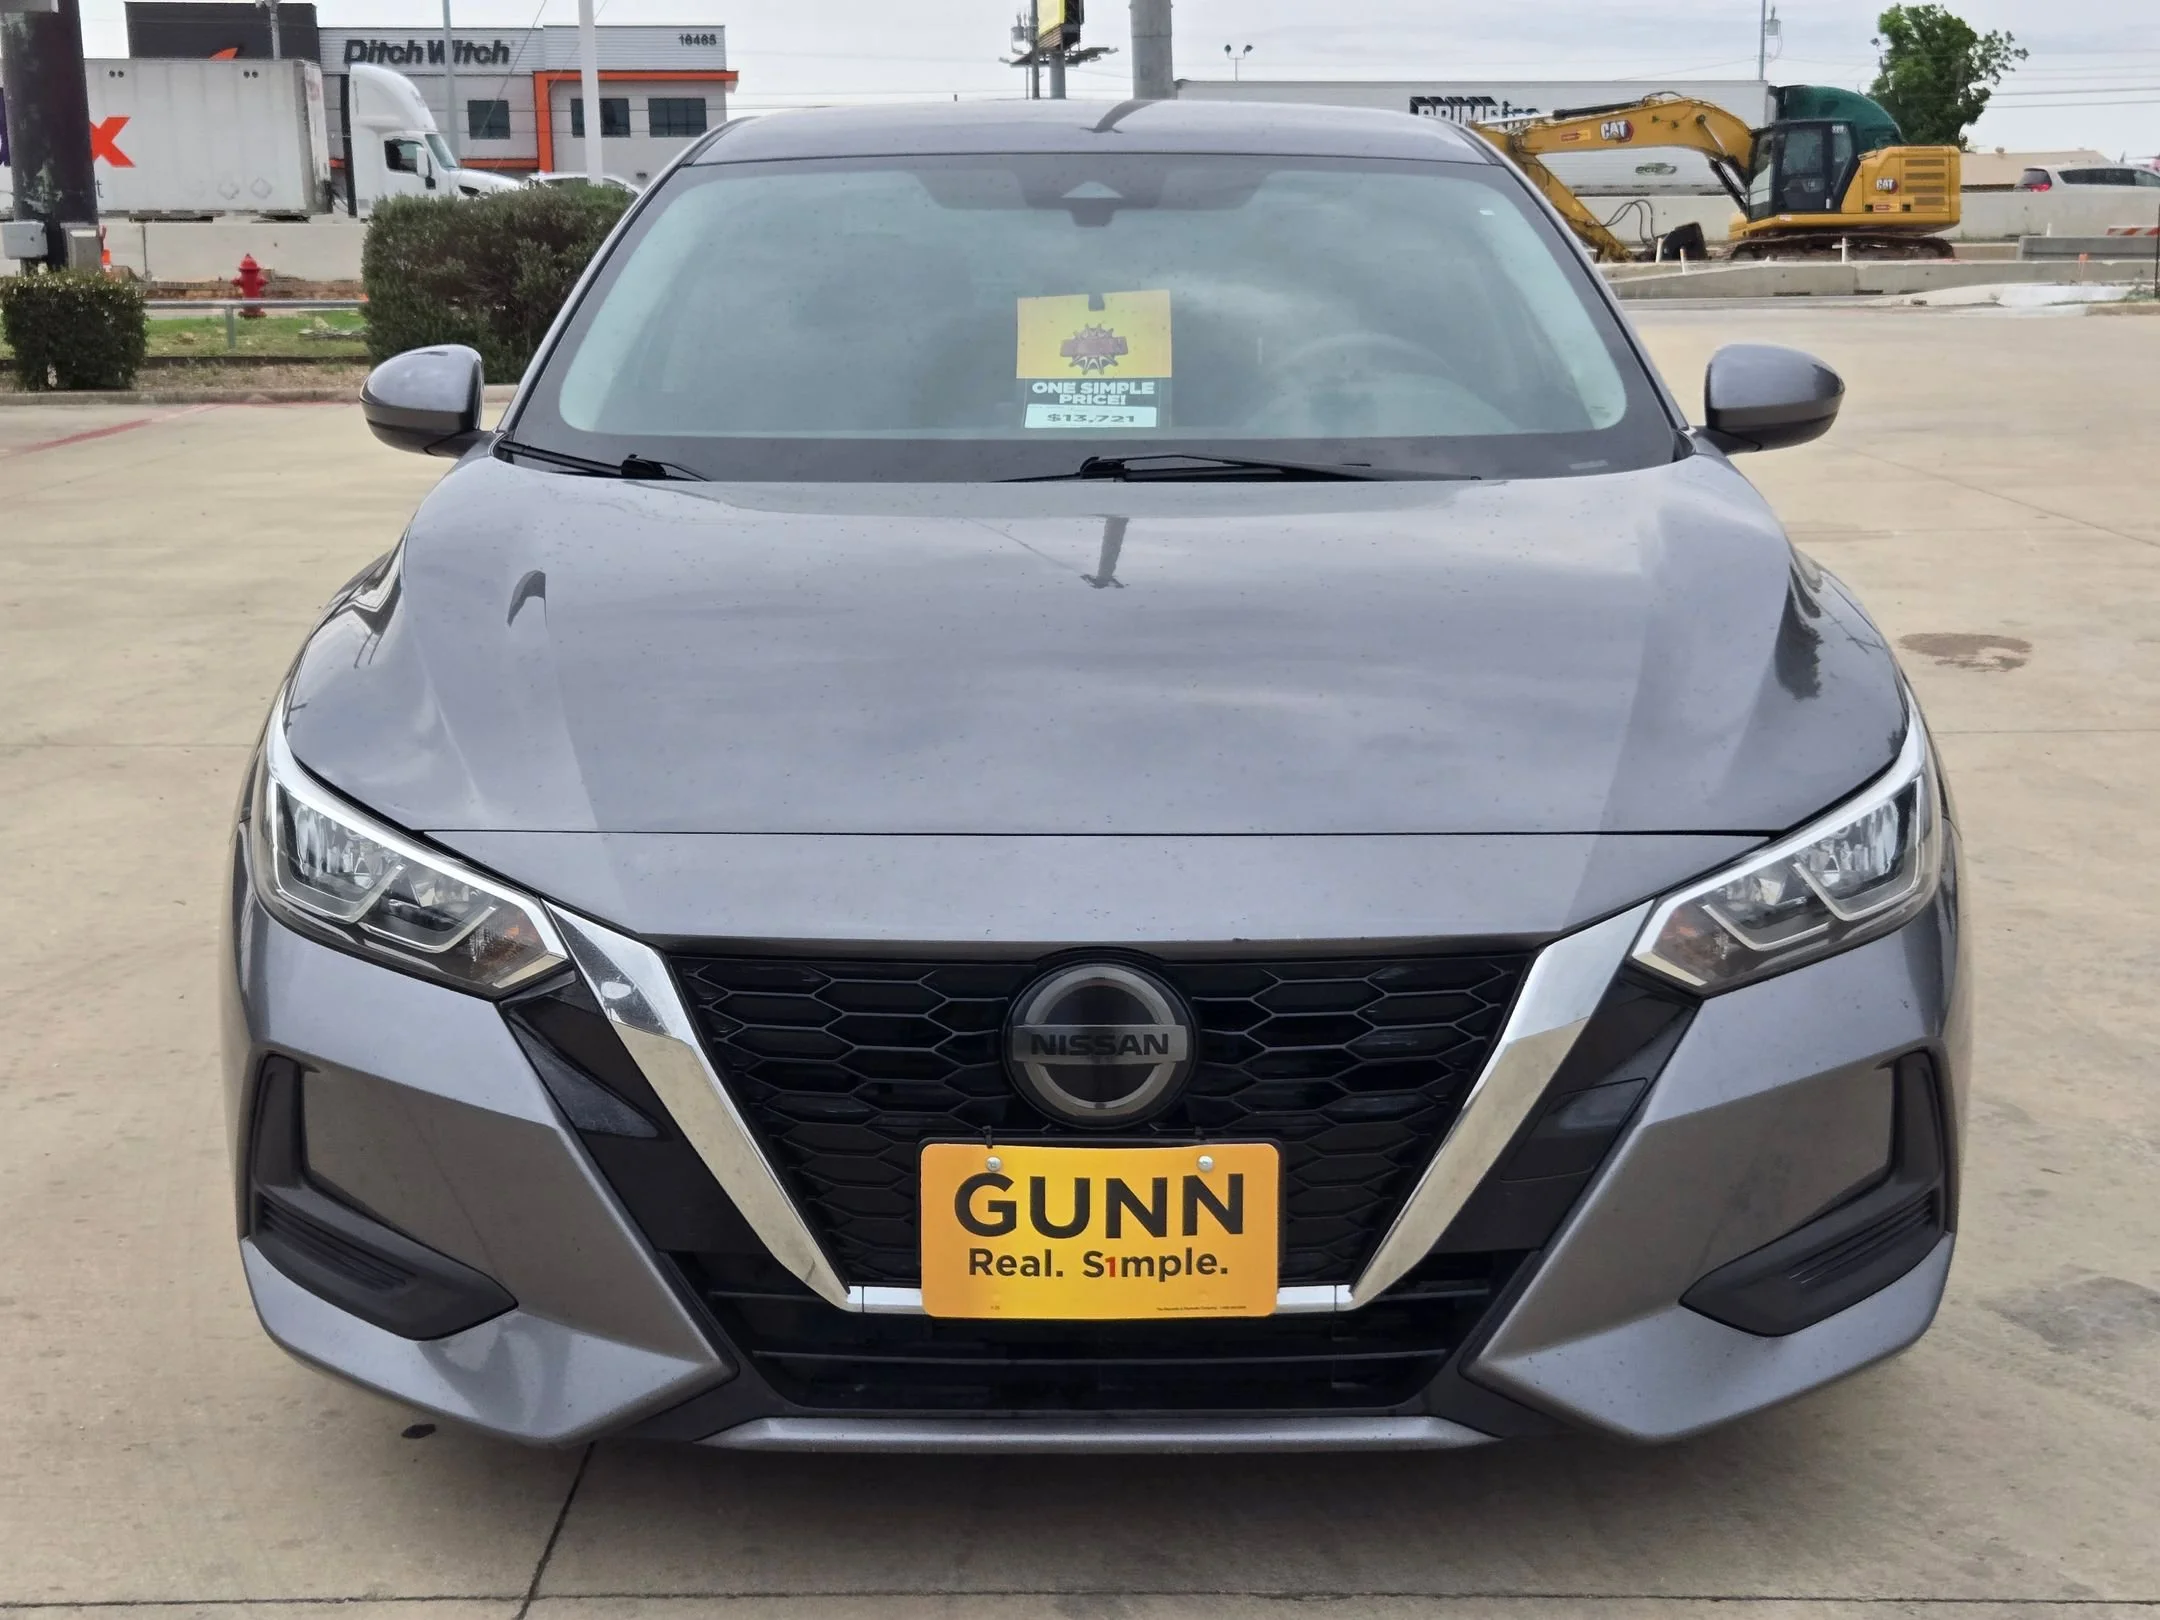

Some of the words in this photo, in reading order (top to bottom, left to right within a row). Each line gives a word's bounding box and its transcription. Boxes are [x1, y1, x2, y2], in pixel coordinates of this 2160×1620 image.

[344, 39, 424, 64] Ditch
[428, 39, 510, 64] Witch
[1601, 121, 1626, 139] CAT
[1875, 178, 1893, 191] CAT
[1032, 382, 1076, 394] ONE
[1081, 382, 1155, 394] SIMPLE
[1059, 394, 1126, 405] PRICE!
[1047, 413, 1135, 423] $13,721
[1031, 1034, 1169, 1055] NISSAN
[954, 1172, 1244, 1239] GUNN
[969, 1248, 1063, 1278] Real.
